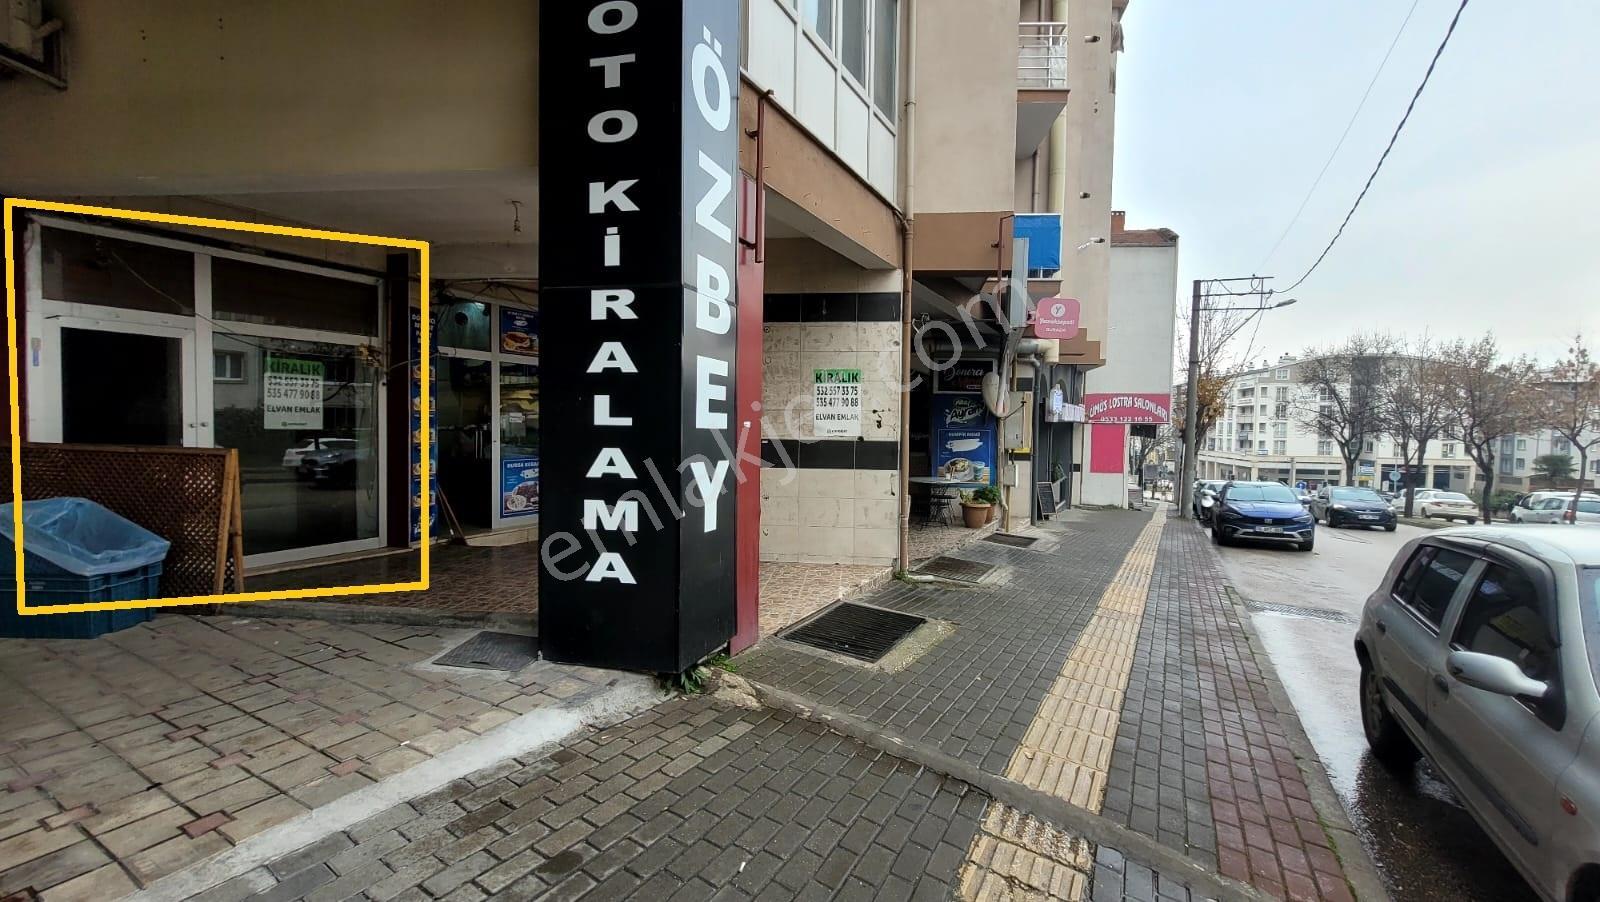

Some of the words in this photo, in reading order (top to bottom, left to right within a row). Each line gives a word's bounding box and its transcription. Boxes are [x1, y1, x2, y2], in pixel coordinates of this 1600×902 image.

[587, 0, 639, 144] OTO
[690, 24, 732, 533] ÖZBEY
[583, 179, 641, 585] KİRALAMA
[816, 386, 828, 396] 532
[841, 386, 850, 396] 33
[850, 386, 859, 396] 75
[266, 388, 282, 399] 535
[283, 388, 299, 400] 477
[299, 389, 310, 400] 90
[266, 404, 293, 414] ELVAN
[294, 405, 321, 415] EMLAK
[815, 413, 836, 421] ELVAN
[836, 413, 859, 421] EMLAK
[1109, 396, 1133, 409] LOSTRA
[1133, 397, 1168, 422] SALONLARI
